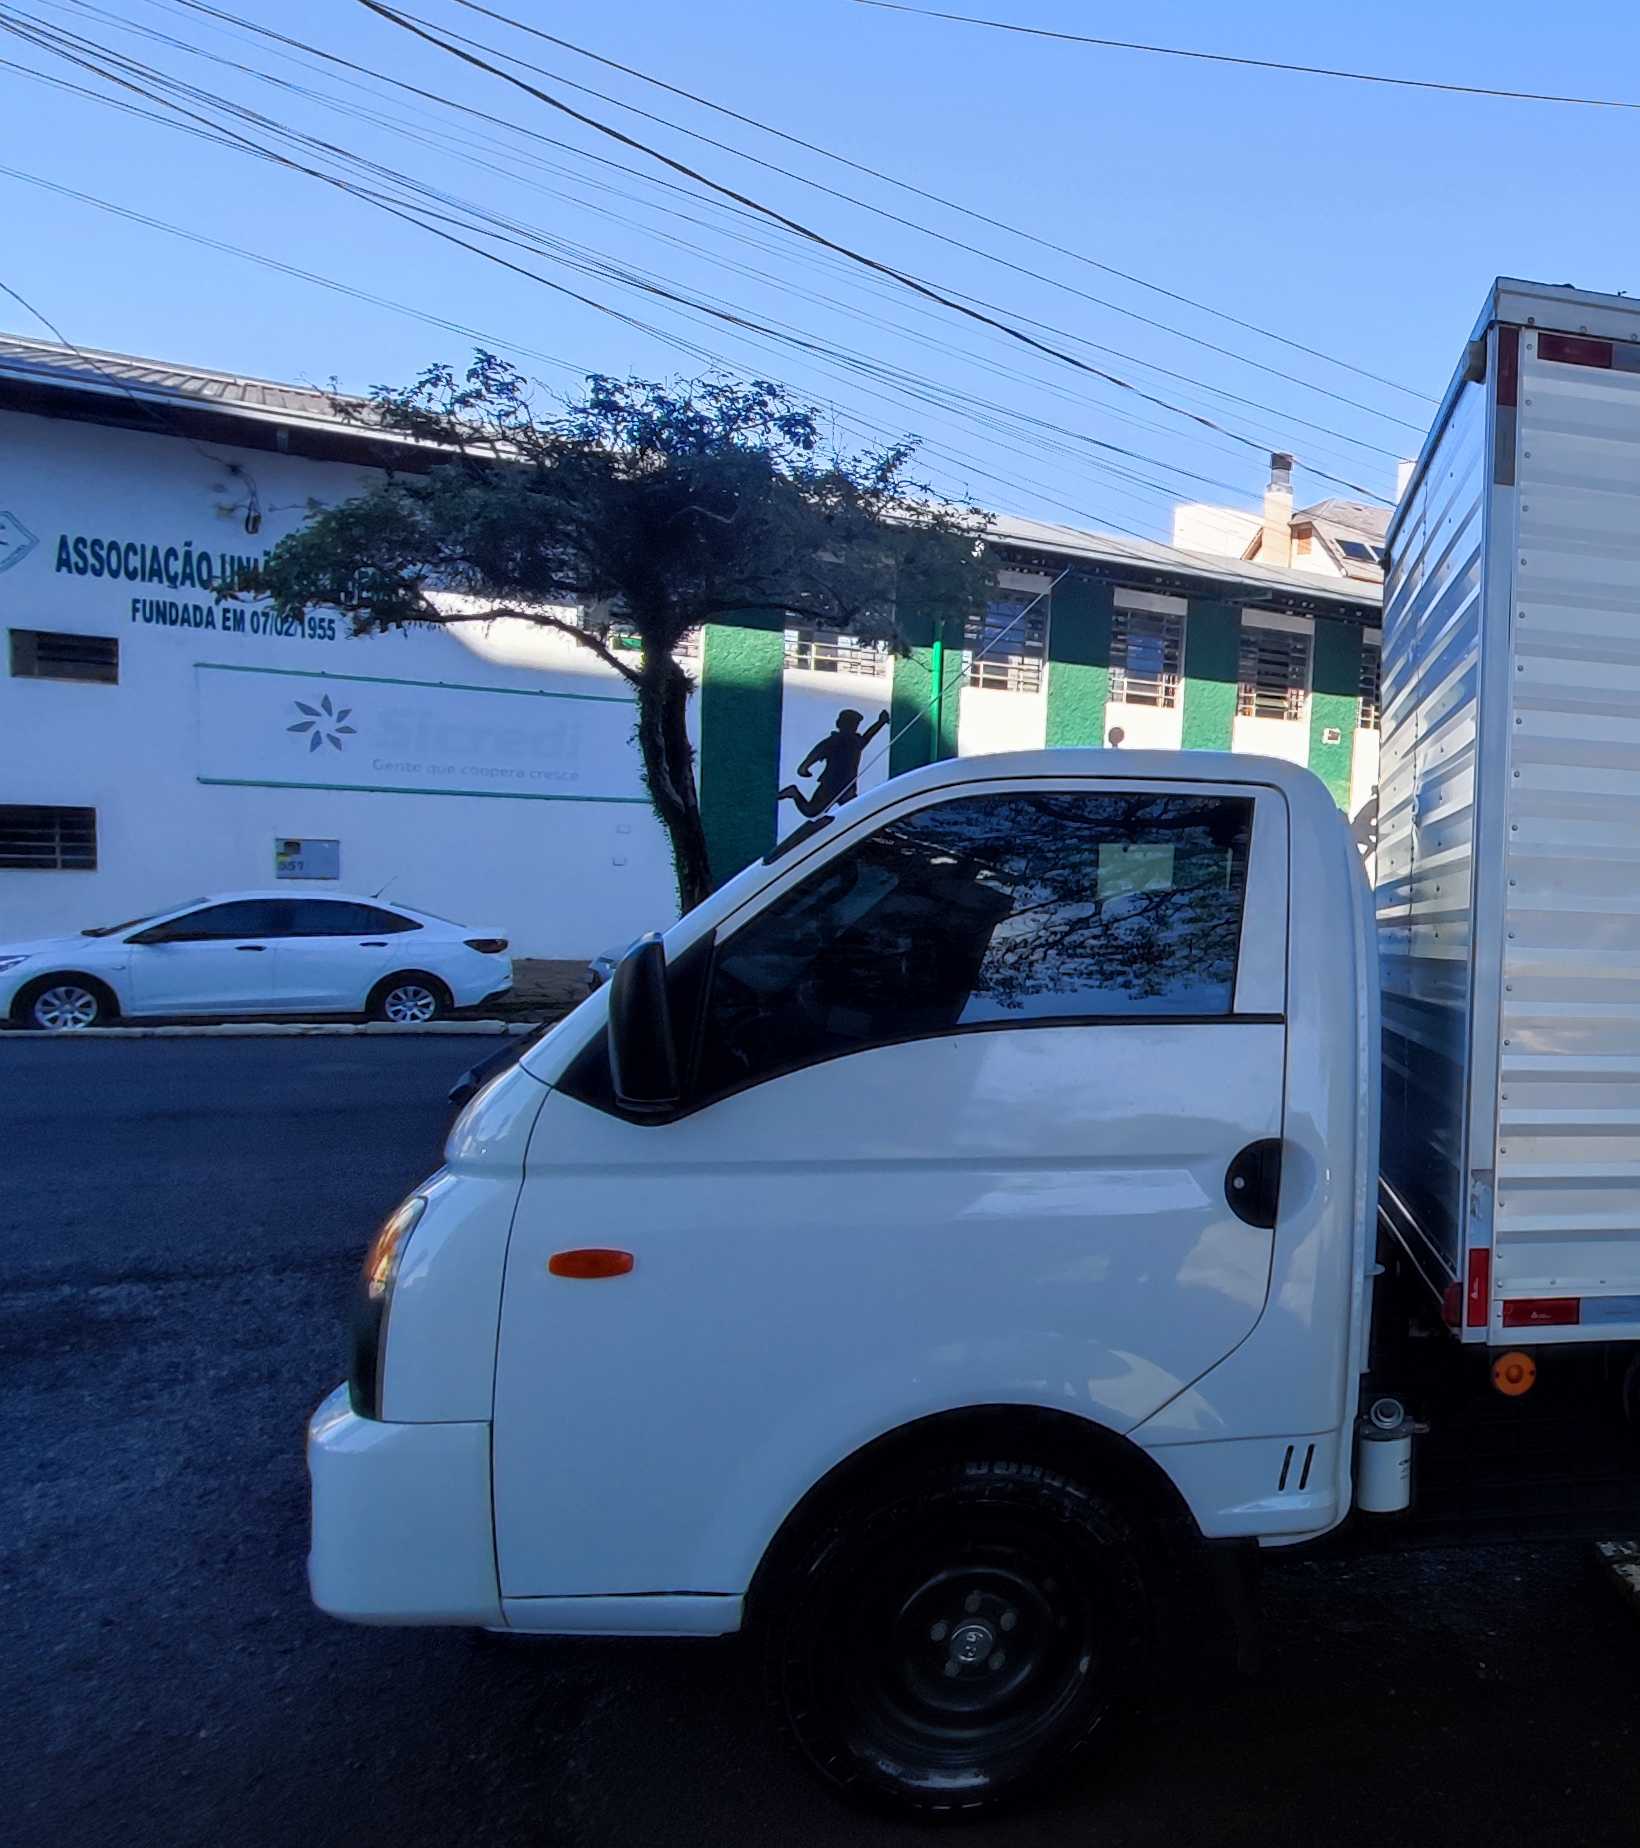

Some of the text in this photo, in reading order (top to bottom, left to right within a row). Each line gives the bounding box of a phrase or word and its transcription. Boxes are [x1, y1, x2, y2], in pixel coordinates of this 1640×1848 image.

[55, 534, 214, 590] ASSOCIAÇÃO
[131, 598, 216, 630] FUNDADA
[222, 607, 246, 633] EM
[371, 758, 580, 782] Gente que coopera cresce
